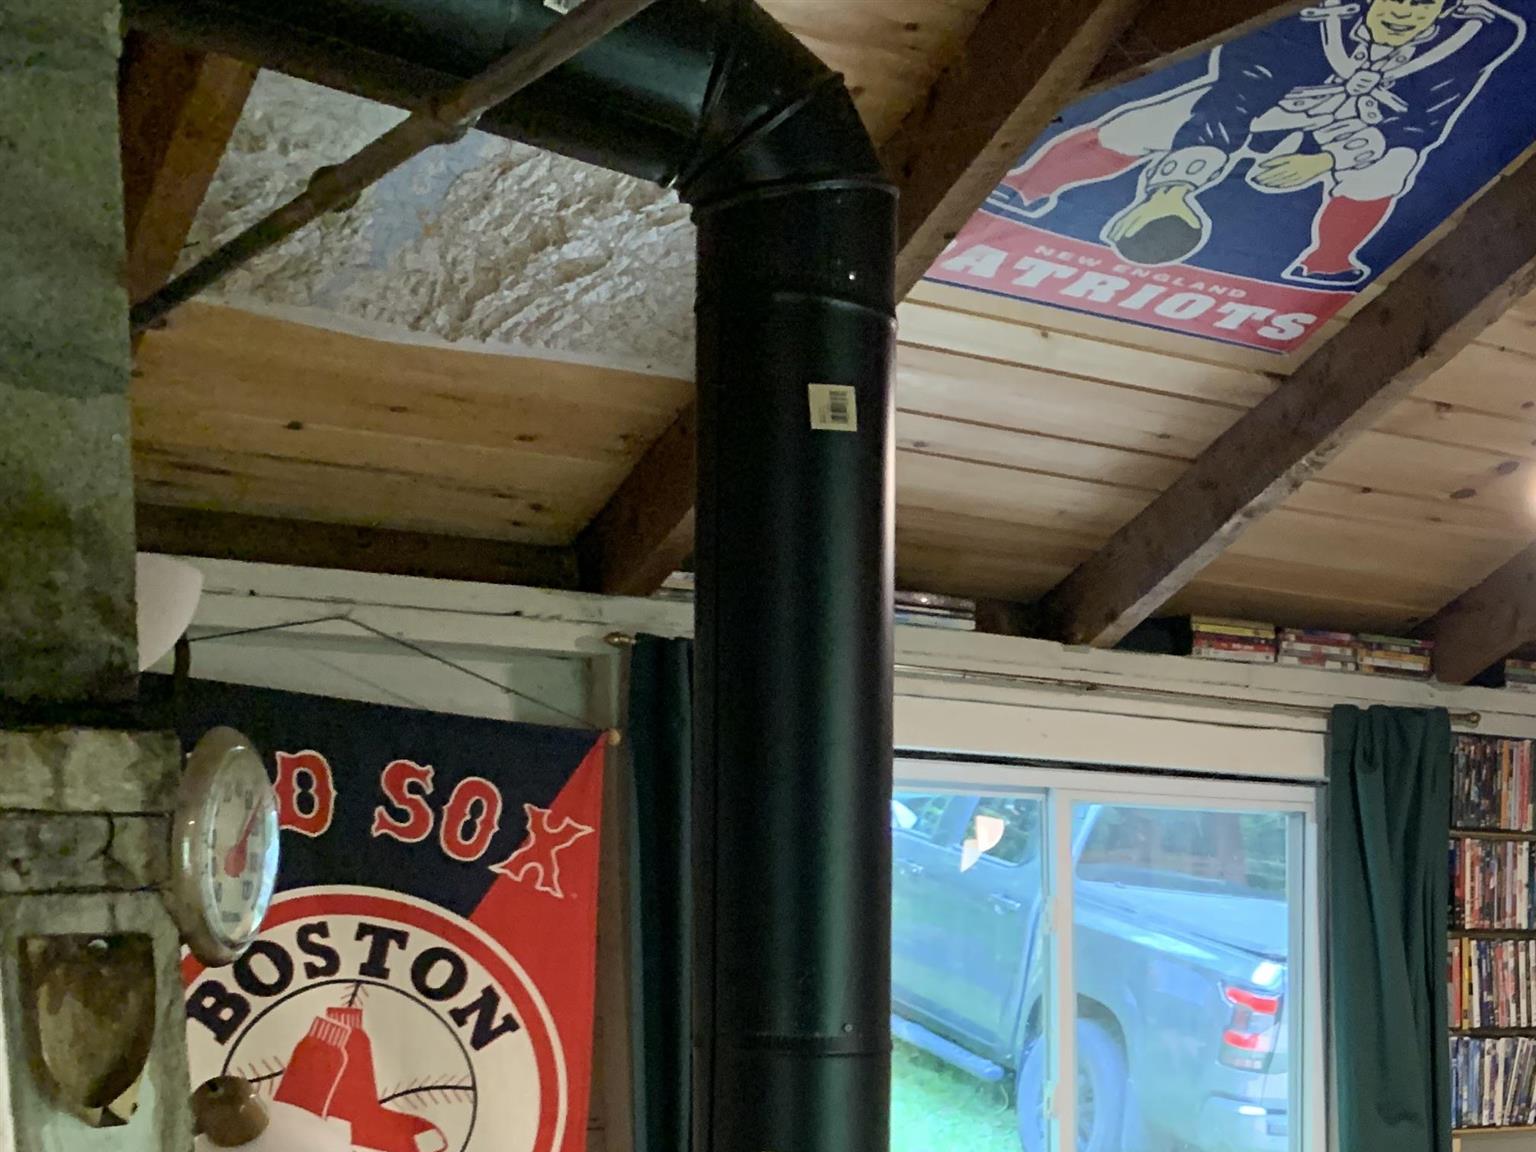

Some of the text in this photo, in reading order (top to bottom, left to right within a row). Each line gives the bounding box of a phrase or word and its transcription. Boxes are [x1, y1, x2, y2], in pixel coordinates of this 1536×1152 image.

[940, 241, 1318, 342] ATRIOTS
[1034, 244, 1247, 298] NEW ENGLAND
[371, 757, 594, 898] SOX
[186, 921, 519, 1053] BOSTON
